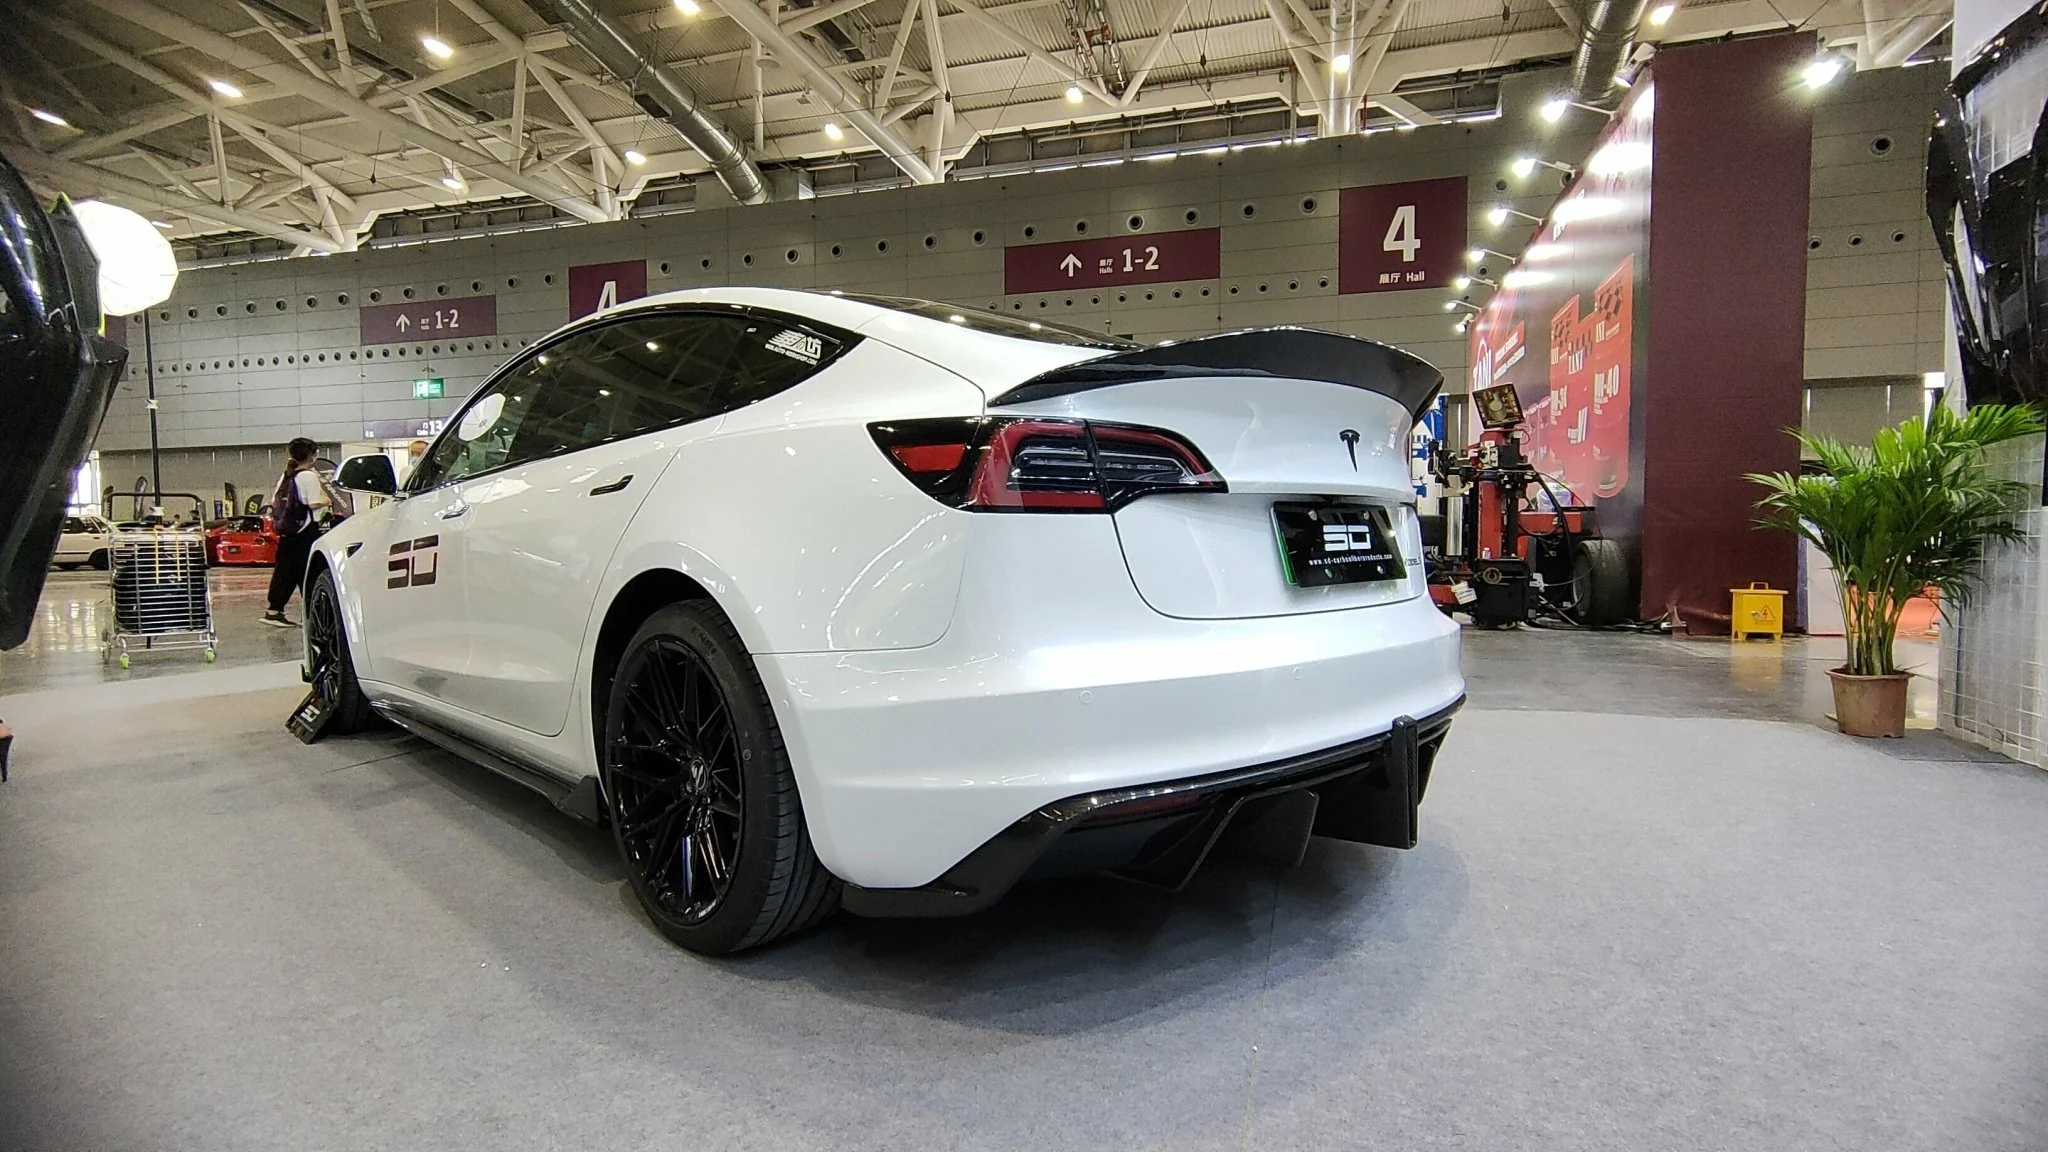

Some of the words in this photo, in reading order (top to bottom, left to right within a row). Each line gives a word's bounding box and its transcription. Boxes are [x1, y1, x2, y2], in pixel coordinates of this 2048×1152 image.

[1383, 204, 1421, 262] 4
[1122, 246, 1160, 272] 1-2
[1406, 270, 1425, 282] Hall
[435, 309, 459, 329] 1-2
